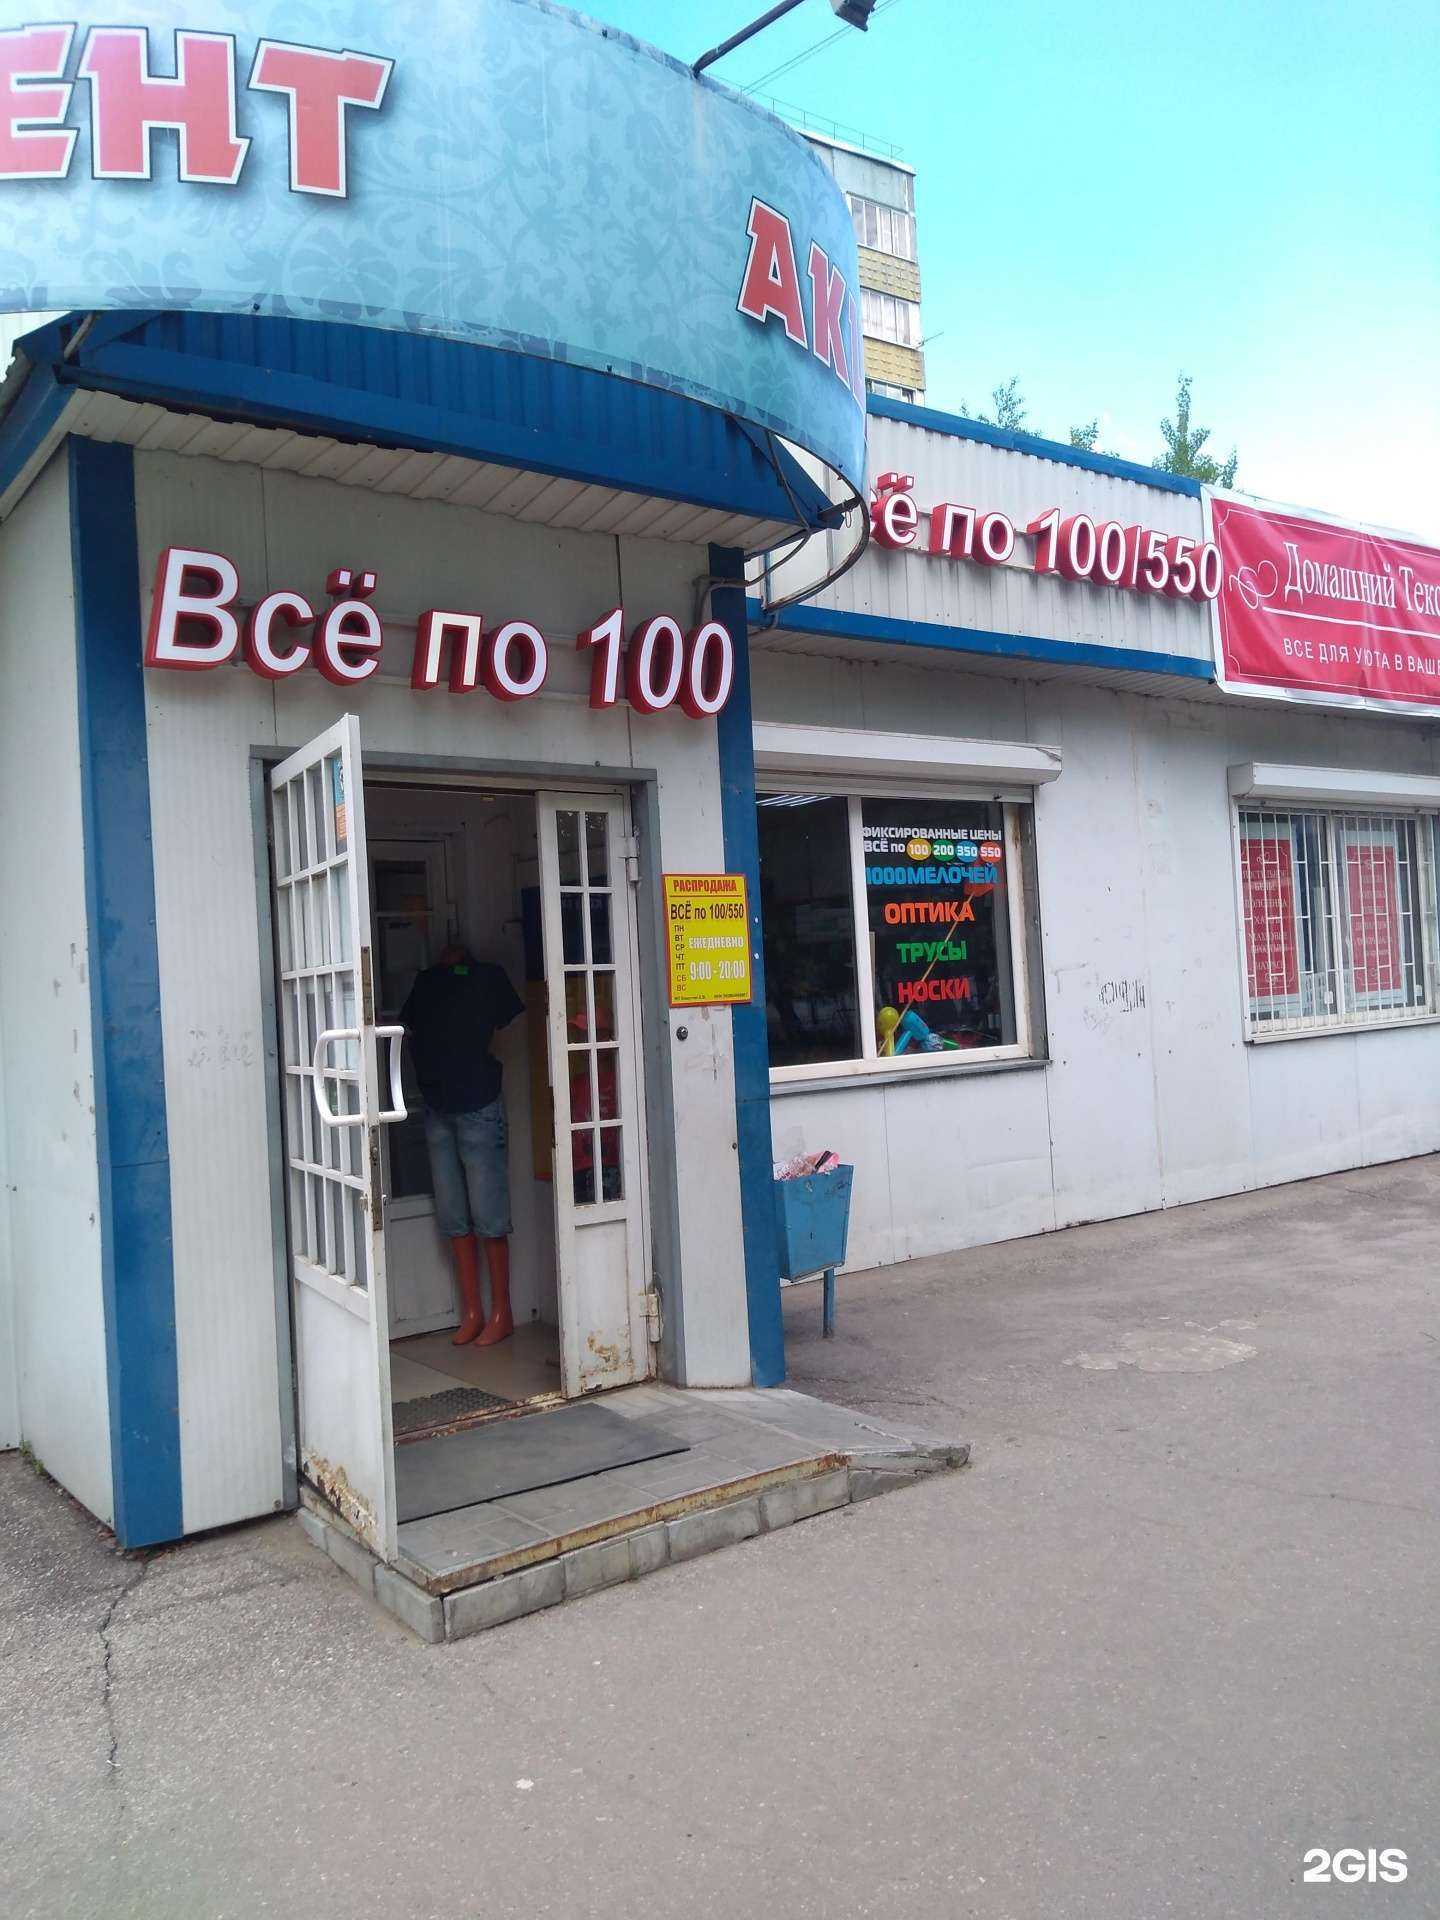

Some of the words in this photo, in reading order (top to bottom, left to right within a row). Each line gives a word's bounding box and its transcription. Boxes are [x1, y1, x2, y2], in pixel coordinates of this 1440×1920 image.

[929, 503, 1015, 565] по
[1283, 541, 1396, 608] Домашний
[145, 546, 384, 686] Всё
[412, 608, 548, 700] по
[577, 608, 734, 718] 100
[1283, 638, 1314, 658] ВСЕ
[1319, 642, 1350, 664] ДЛЯ
[1353, 647, 1391, 669] УЮТА
[1395, 654, 1403, 670] В
[863, 827, 968, 840] ФИКСИРОВАННЫЕ
[970, 829, 1002, 841] ЦЕНЫ
[864, 838, 888, 853] ВСЁ
[891, 842, 906, 853] по
[909, 844, 929, 855] 100
[933, 845, 954, 856] 200
[956, 845, 978, 857] 350
[979, 846, 1001, 858] 550
[673, 879, 737, 893] РАСПРОДАЖА
[671, 901, 691, 919] ВСЁ
[695, 907, 706, 919] по
[709, 903, 744, 919] 100/550
[884, 901, 976, 924] ОПТИКА
[688, 935, 744, 950] ЕЖЕДНЕВНО
[896, 941, 967, 963] ТРУСЫ
[898, 977, 971, 1003] НОСКИ
